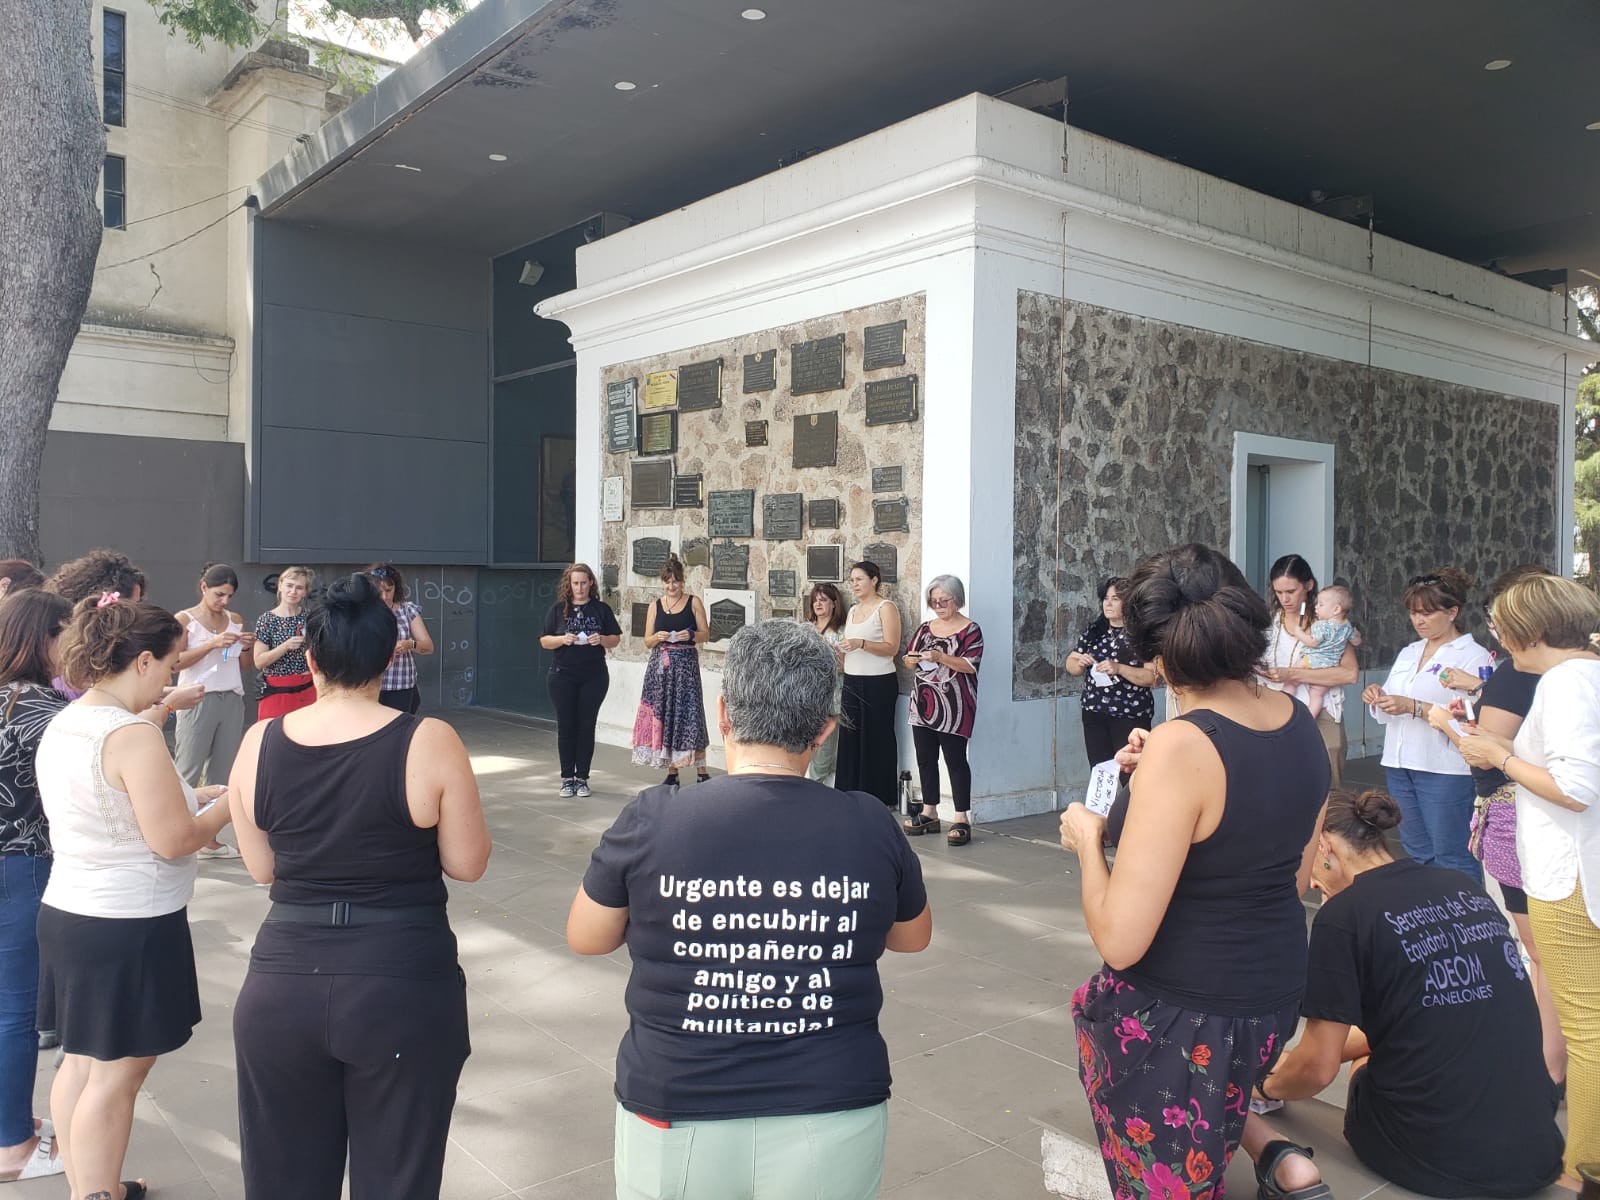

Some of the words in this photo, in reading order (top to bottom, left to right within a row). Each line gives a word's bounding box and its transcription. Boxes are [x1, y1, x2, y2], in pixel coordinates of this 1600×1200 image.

[660, 875, 763, 903] Urgente
[772, 880, 803, 898] es
[811, 875, 870, 904] dejar
[1443, 895, 1467, 919] de
[672, 909, 703, 931] de
[712, 908, 830, 932] encubrir
[837, 910, 858, 932] al
[673, 939, 824, 964] compañero
[831, 939, 854, 960] al
[1401, 926, 1449, 965] Equidad
[1448, 931, 1459, 954] y
[694, 969, 777, 994] amigo
[784, 975, 800, 994] y
[808, 967, 832, 990] al
[1424, 951, 1486, 992] ADEOM
[687, 991, 793, 1012] político
[801, 992, 834, 1011] de
[1421, 983, 1494, 1008] CANELONES
